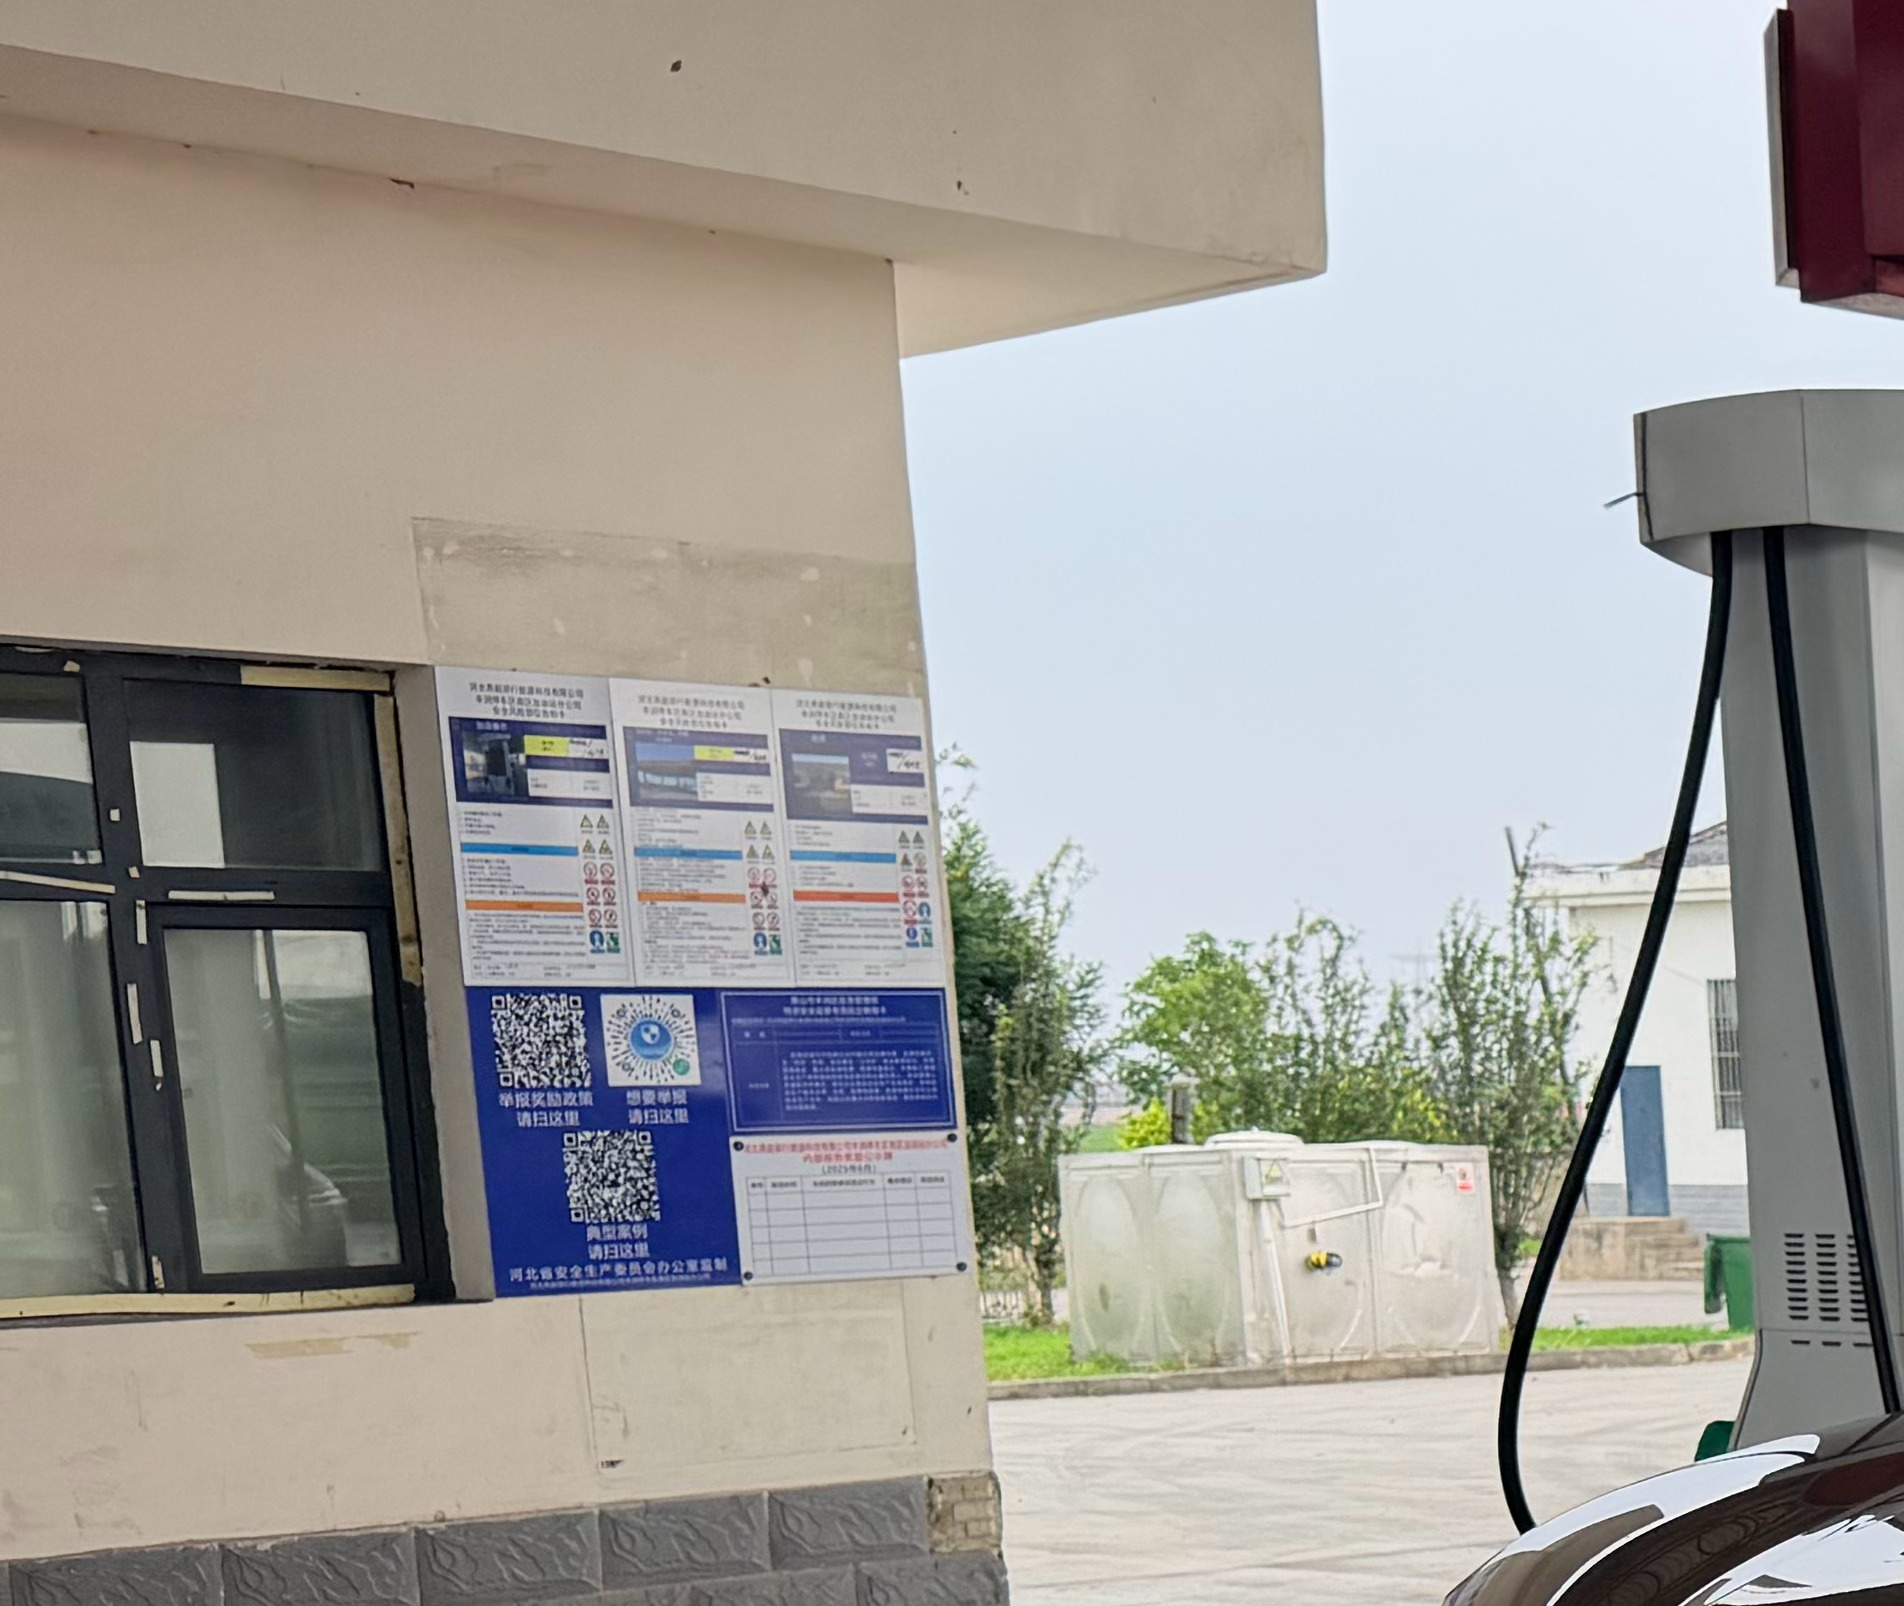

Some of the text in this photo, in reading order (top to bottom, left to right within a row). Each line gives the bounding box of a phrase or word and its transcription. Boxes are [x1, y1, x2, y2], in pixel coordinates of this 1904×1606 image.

[499, 1091, 593, 1108] 举报奖励政策
[626, 1089, 688, 1105] 想要举报
[517, 1111, 580, 1127] 请扫这里
[629, 1108, 689, 1124] 请扫这里
[586, 1224, 648, 1241] 典型案例
[588, 1242, 650, 1260] 请扫这里
[509, 1257, 728, 1282] 河北省安全生产委员会办公室监制
